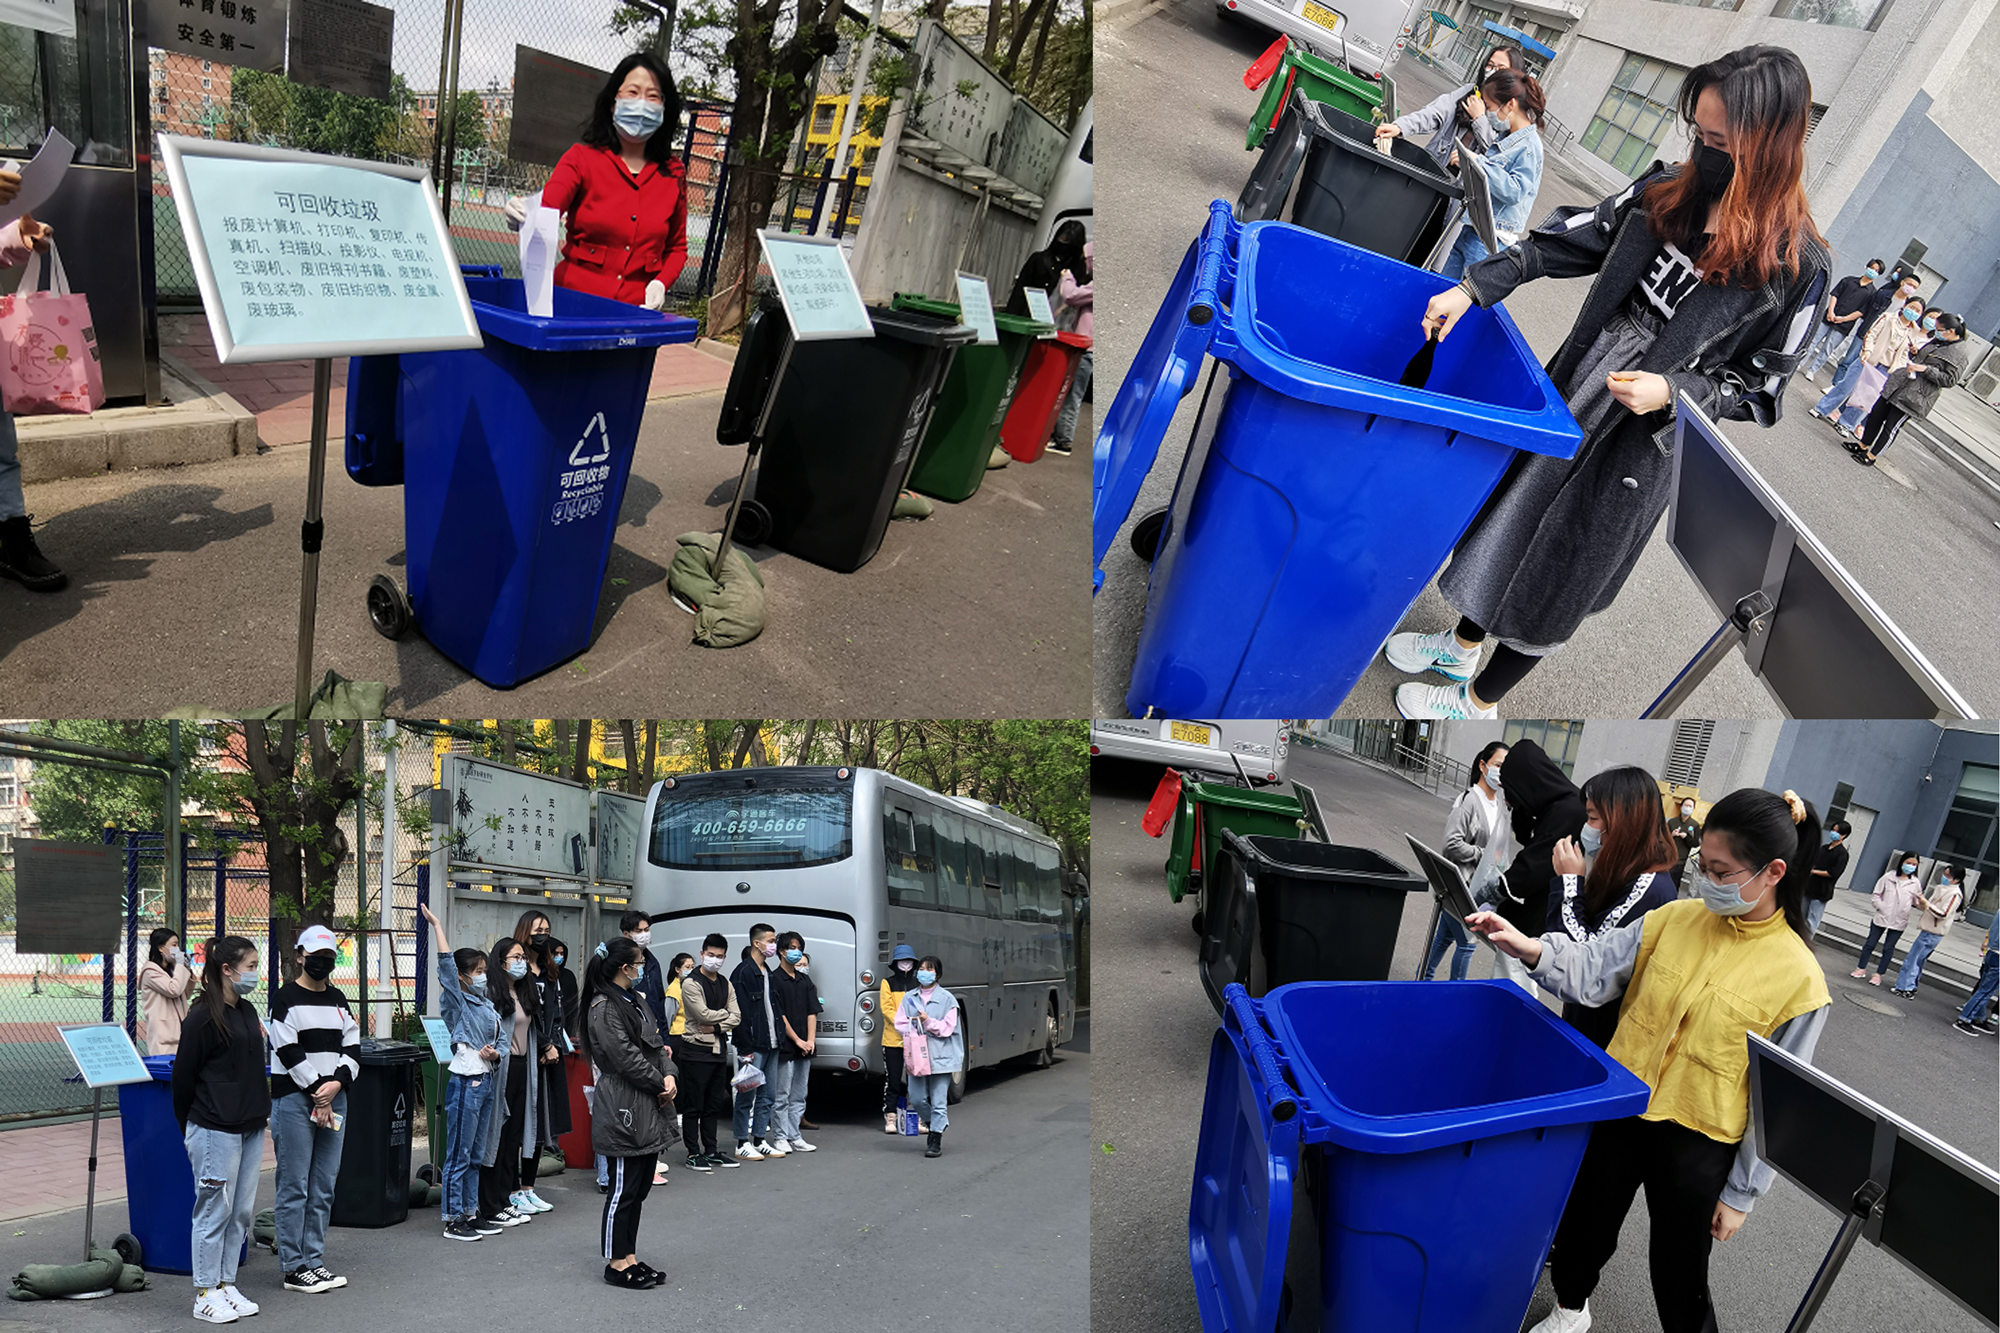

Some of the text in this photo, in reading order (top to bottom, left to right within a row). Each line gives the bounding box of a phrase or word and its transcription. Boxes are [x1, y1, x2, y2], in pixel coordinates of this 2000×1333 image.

[178, 23, 256, 51] 安全第一
[274, 191, 381, 222] 可回收垃圾
[247, 302, 304, 317] 废玻璃。
[560, 465, 610, 488] 可回收物
[1172, 728, 1209, 745] E7088
[691, 818, 807, 835] 400-659-6666
